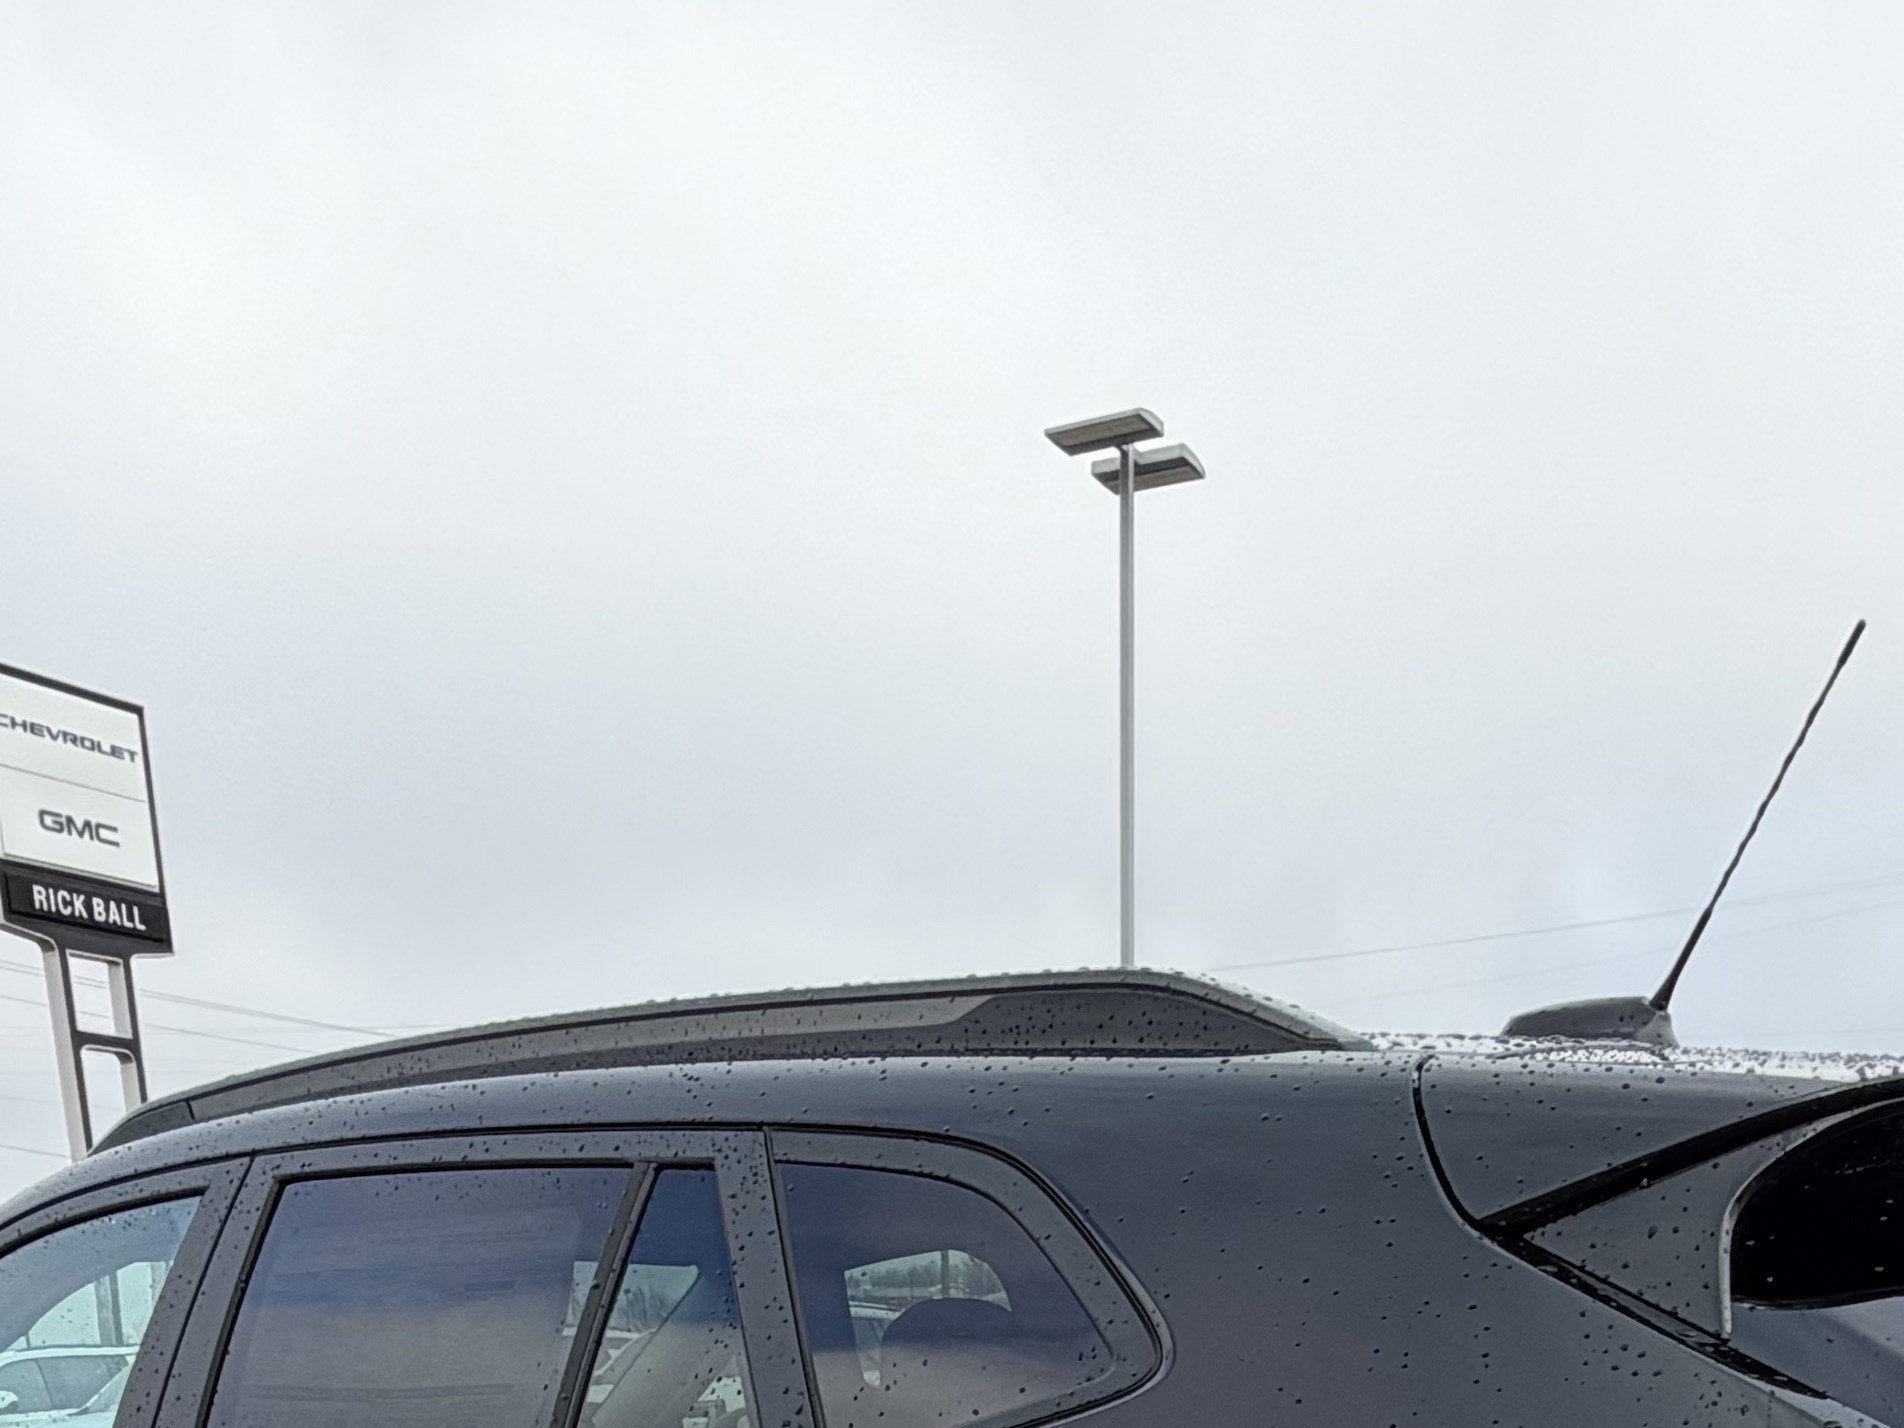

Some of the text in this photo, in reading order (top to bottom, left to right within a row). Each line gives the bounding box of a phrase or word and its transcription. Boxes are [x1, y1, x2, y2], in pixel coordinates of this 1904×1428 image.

[37, 808, 122, 848] GMC
[32, 883, 147, 932] RICK BALL
